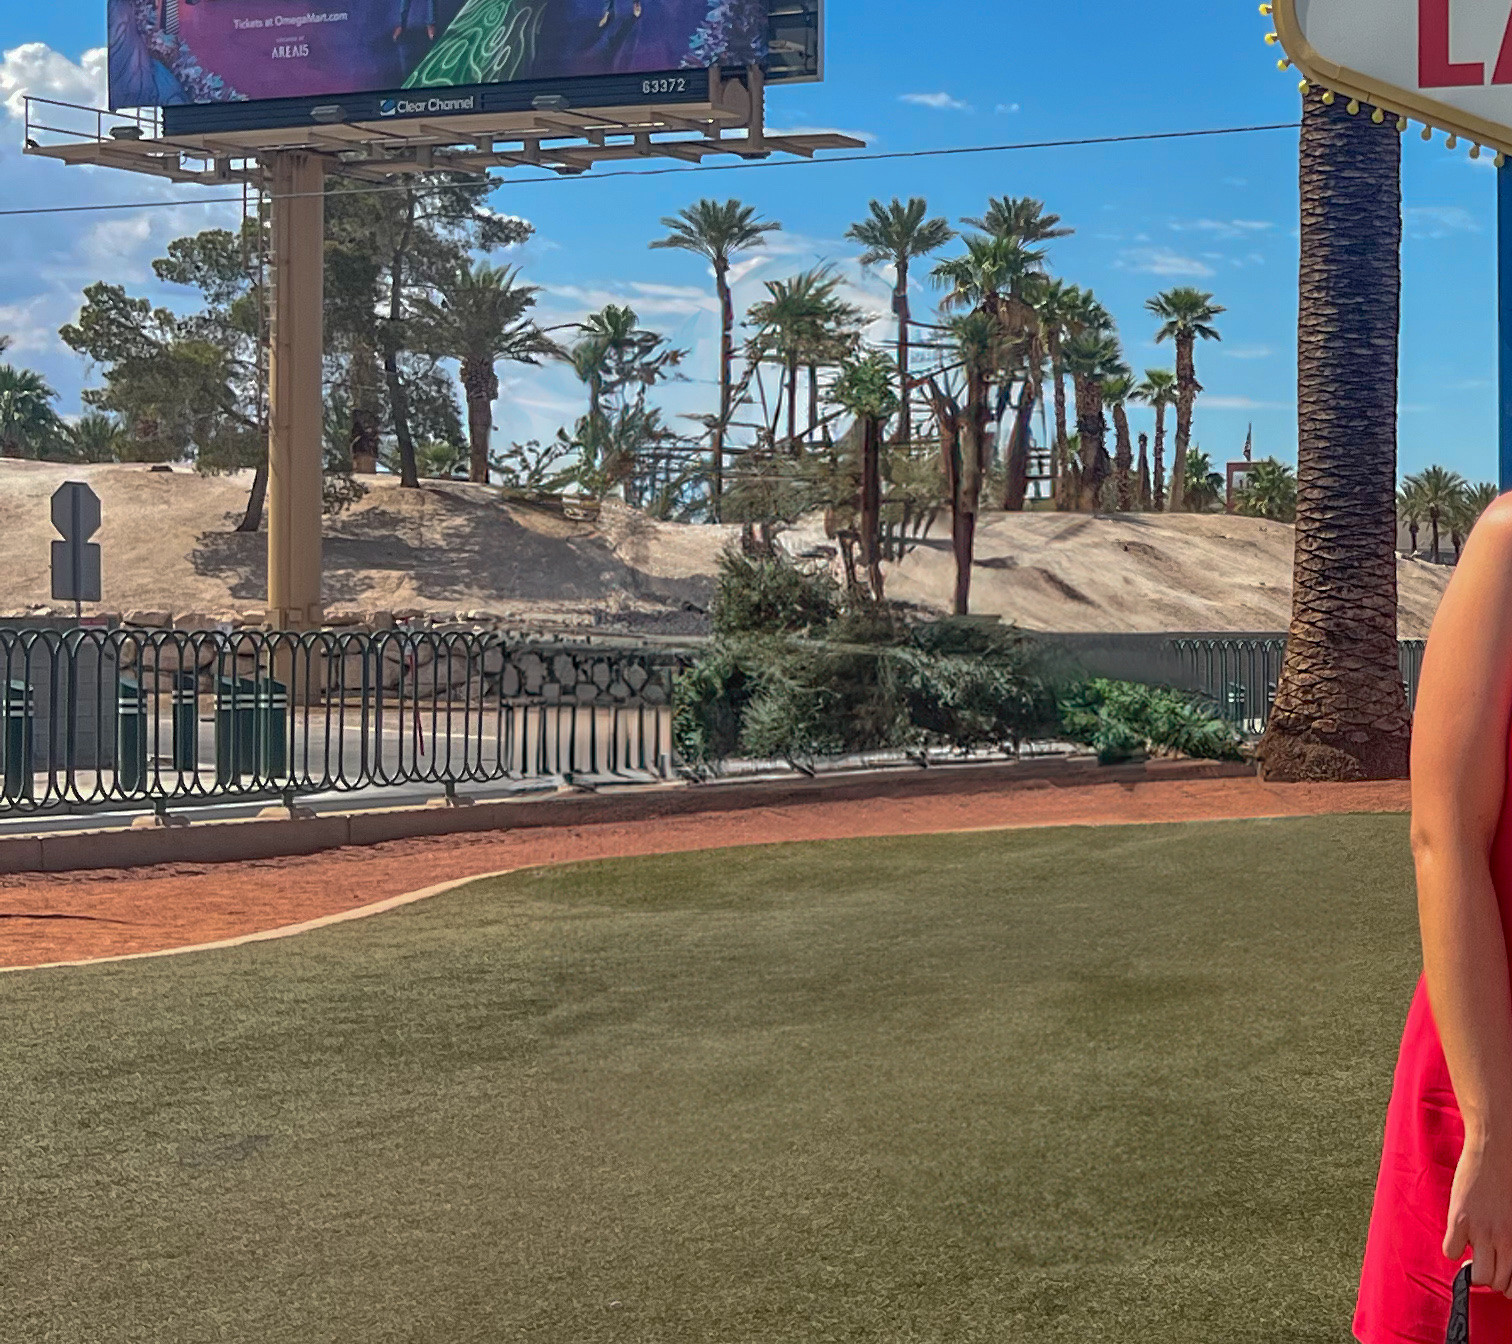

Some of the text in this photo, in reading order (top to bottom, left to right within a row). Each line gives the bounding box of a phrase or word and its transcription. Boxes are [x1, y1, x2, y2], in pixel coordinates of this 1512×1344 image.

[233, 18, 263, 30] Tickets
[265, 18, 274, 27] at
[398, 96, 474, 114] Clear Channel
